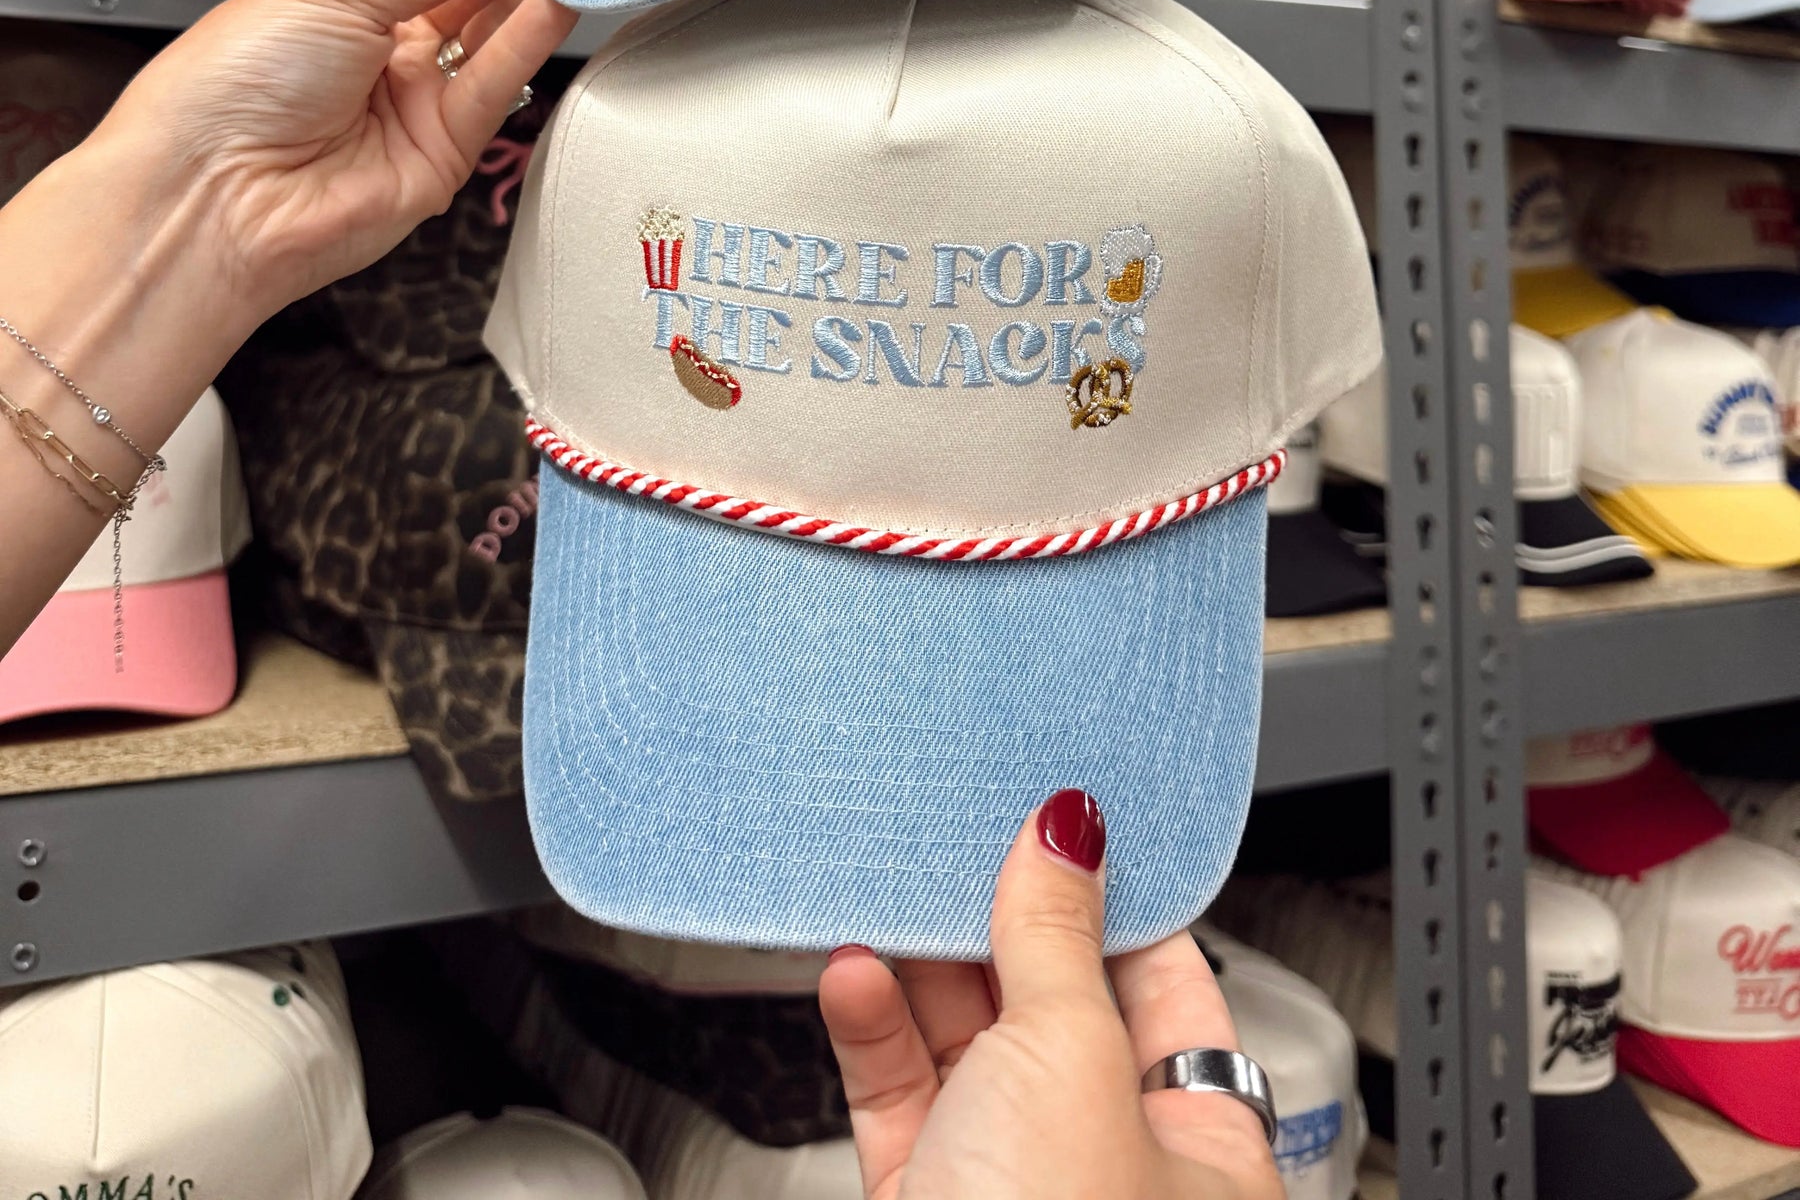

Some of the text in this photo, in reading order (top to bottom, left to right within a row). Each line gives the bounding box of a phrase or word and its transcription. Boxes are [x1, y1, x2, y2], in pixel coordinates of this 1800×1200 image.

[688, 217, 1098, 309] HERE FOR
[642, 288, 1147, 388] THE SNACKS
